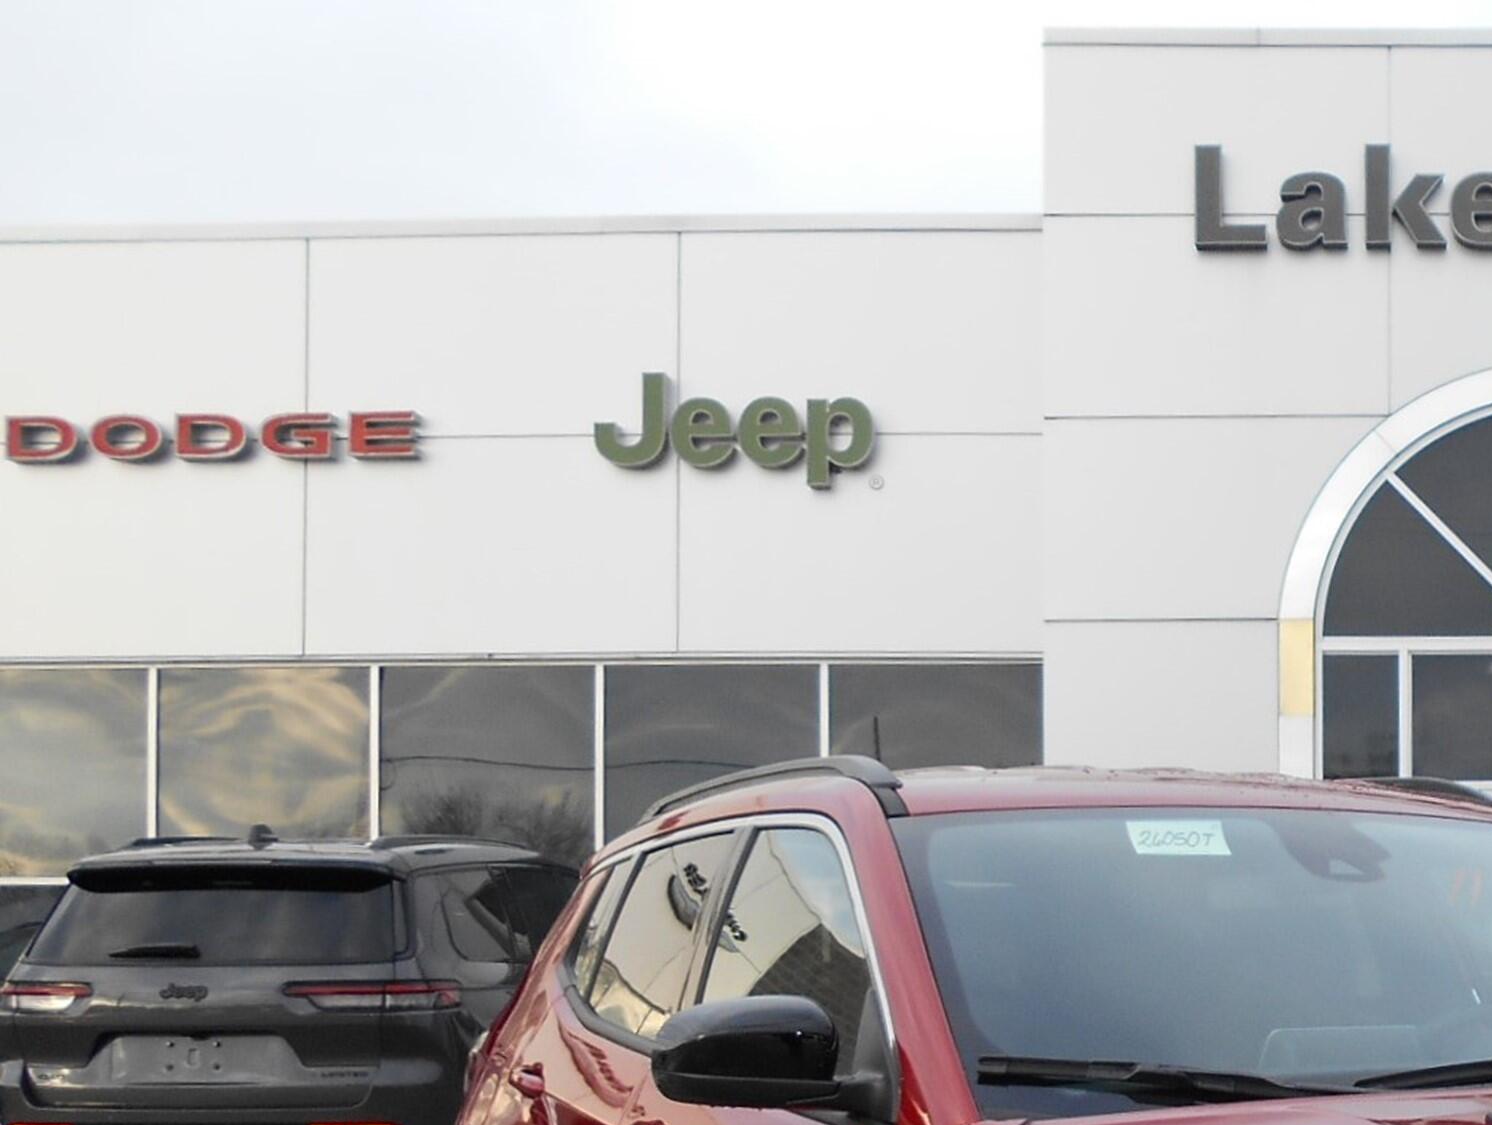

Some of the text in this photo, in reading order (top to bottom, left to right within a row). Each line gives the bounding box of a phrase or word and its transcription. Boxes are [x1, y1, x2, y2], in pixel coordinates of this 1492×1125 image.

[4, 409, 421, 462] DODGE
[593, 371, 878, 490] Jeep
[158, 981, 209, 1002] Jeep
